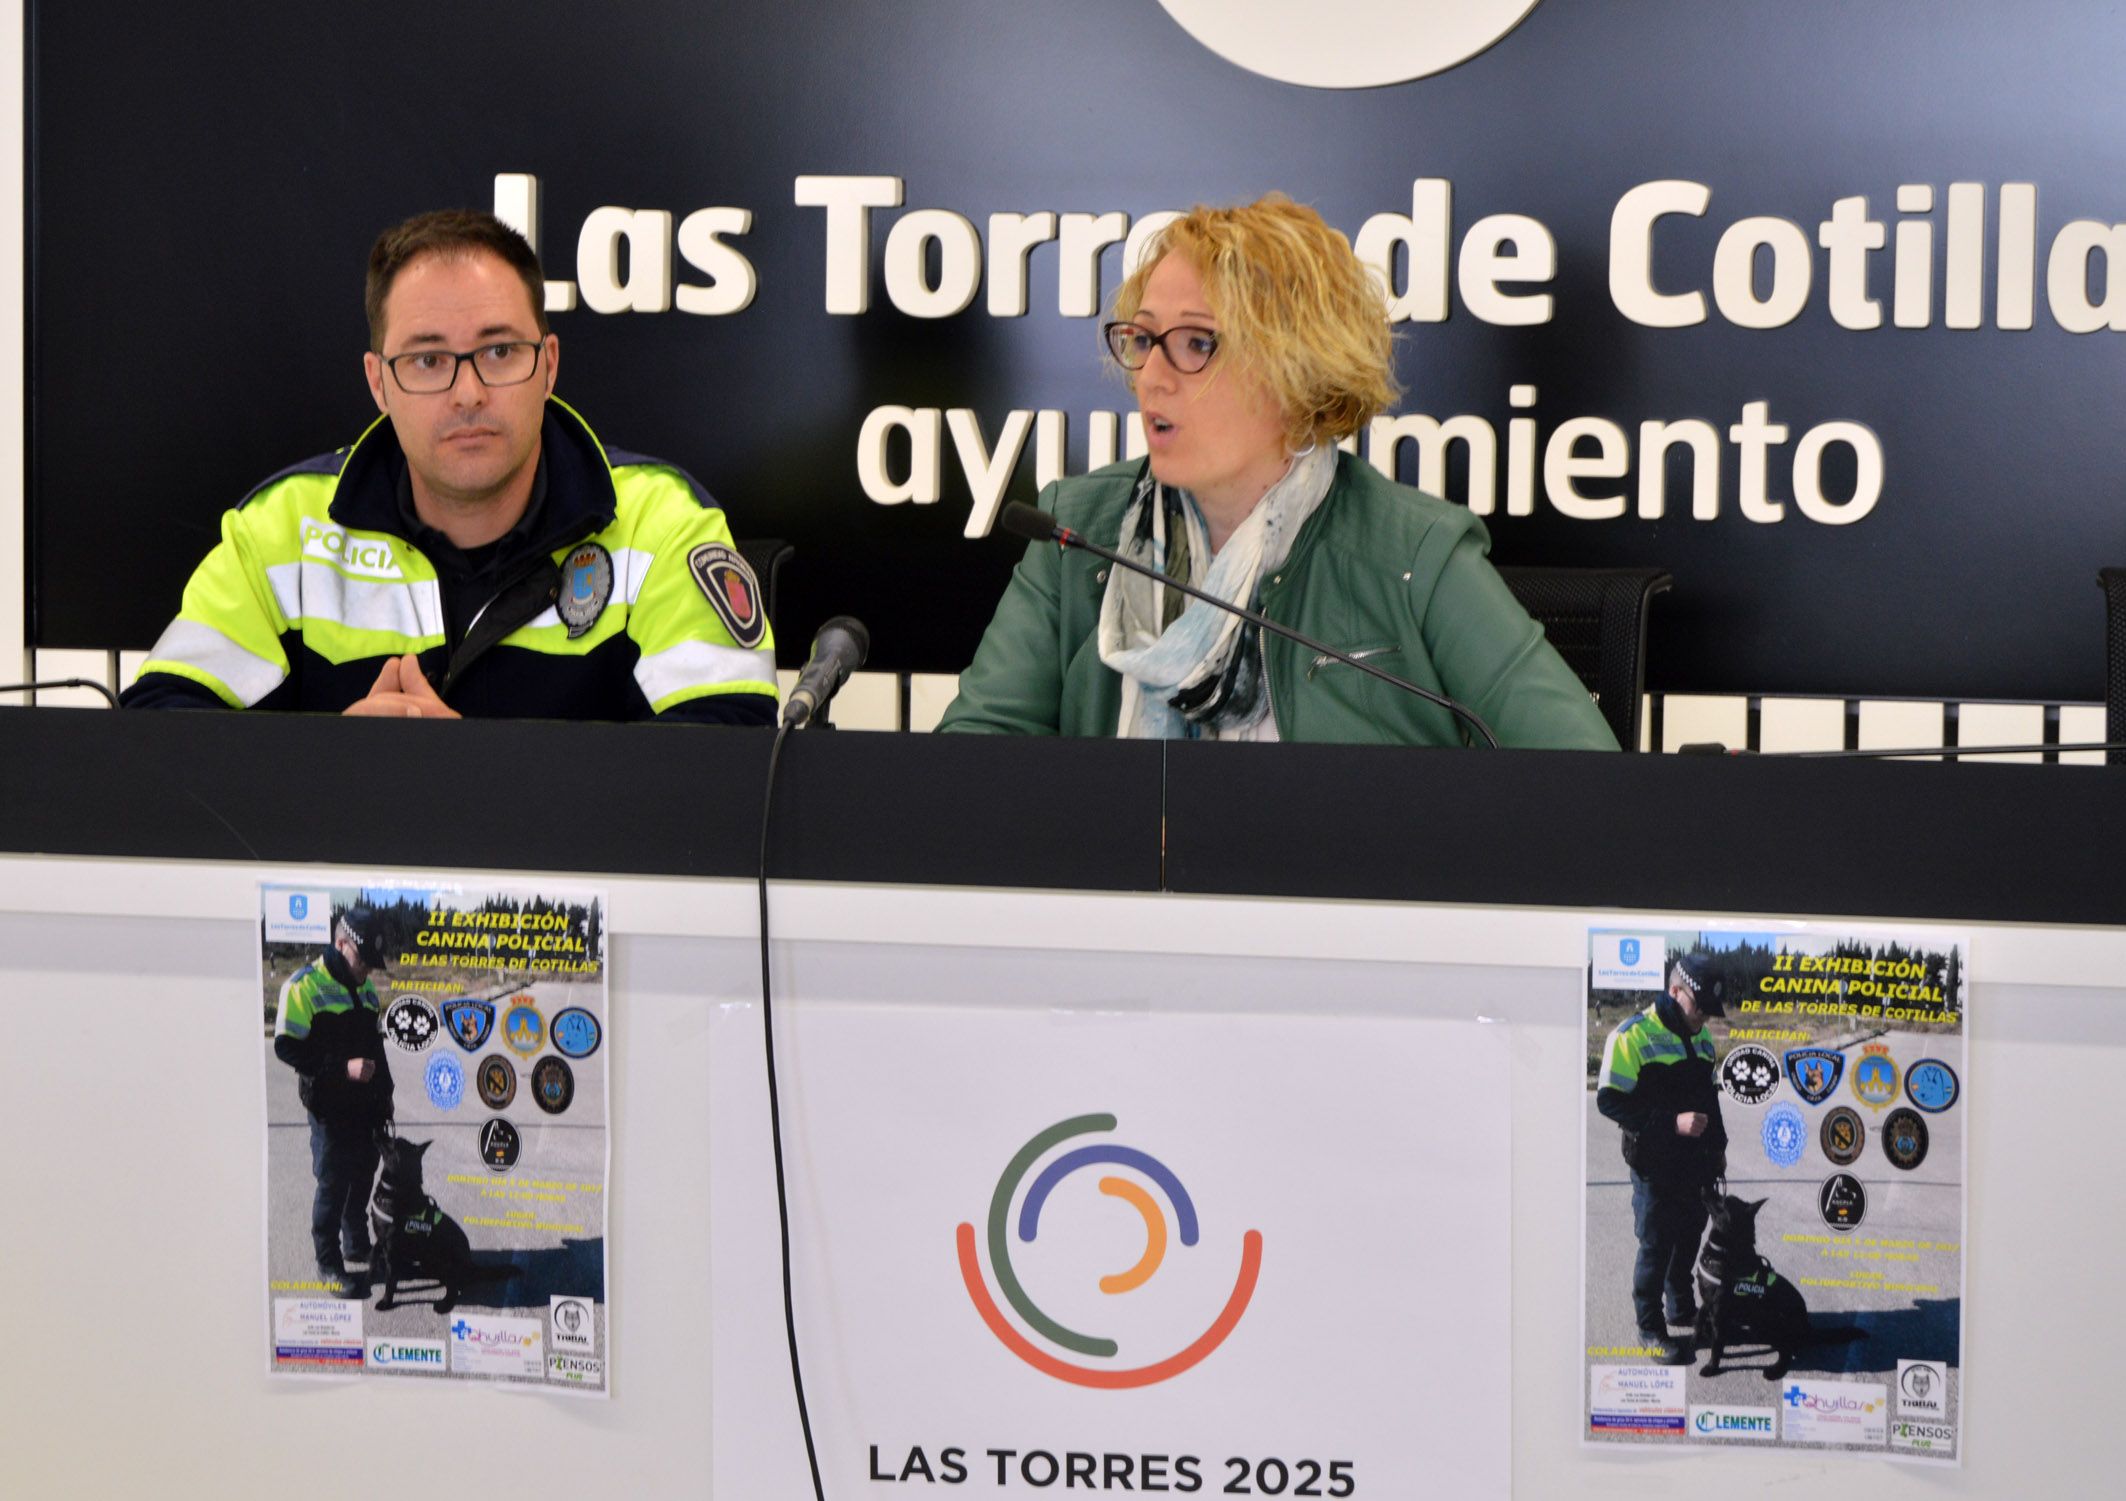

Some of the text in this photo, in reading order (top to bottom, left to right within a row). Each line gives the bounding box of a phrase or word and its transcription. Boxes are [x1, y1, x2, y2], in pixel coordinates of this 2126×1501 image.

[494, 173, 757, 315] Las
[795, 175, 1188, 319] Torr
[1354, 179, 1555, 326] de
[428, 910, 569, 931] II EXHIBICIÓN
[417, 930, 585, 952] CANINA POLICIAL
[400, 953, 600, 974] DE LAS TORRES DE COTILLAS
[1773, 955, 1926, 979] II EXHIBICIÓN
[1760, 977, 1943, 1002] CANINA POLICIAL
[1741, 1000, 1958, 1023] DE LAS TORRES DE COTILLAS
[1729, 1028, 1811, 1041] PARTICIPAN:
[373, 1342, 442, 1364] CLEMENTE
[1618, 1380, 1674, 1389] MANUEL LÓPEZ
[1696, 1411, 1771, 1432] CLEMENTE
[1893, 1423, 1951, 1440] PIENSOS
[869, 1444, 1356, 1498] LAS TORRES 2025
